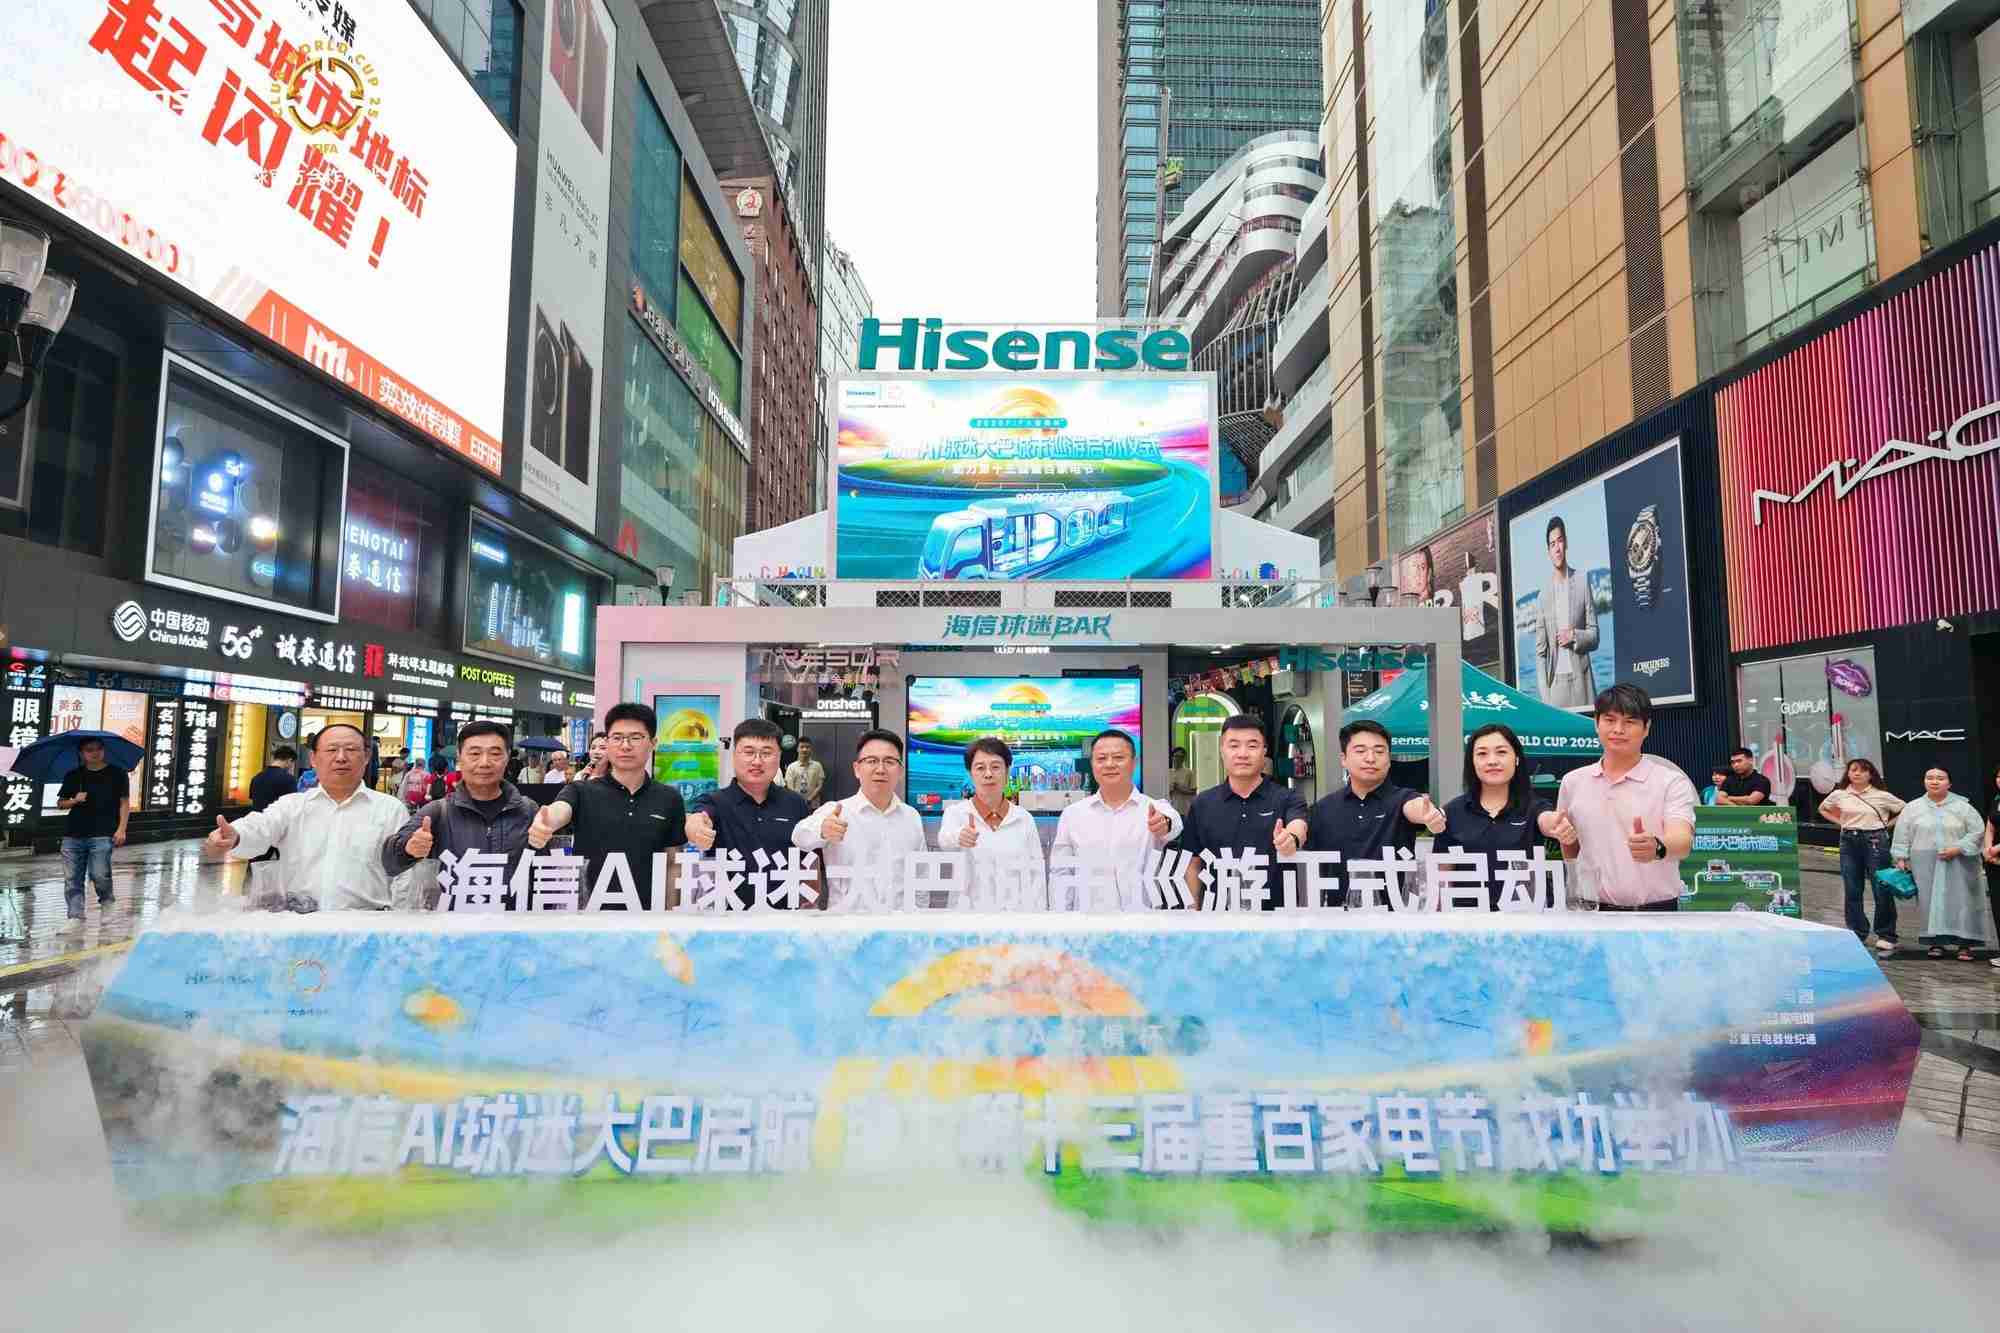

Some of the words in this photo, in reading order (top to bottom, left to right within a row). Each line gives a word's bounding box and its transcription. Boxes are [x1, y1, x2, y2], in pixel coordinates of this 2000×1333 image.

[859, 317, 1191, 371] Hisense
[347, 524, 405, 561] ENGTAI
[150, 607, 210, 636] 中国移动
[942, 613, 1112, 641] 海信球迷BAR
[149, 629, 178, 647] China
[178, 634, 209, 650] Mobile
[275, 633, 356, 674] 诚泰通信
[461, 666, 481, 681] POST
[3, 697, 41, 811] 眼镜发
[1390, 736, 1431, 745] sense
[1543, 736, 1567, 747] CUP
[1570, 738, 1600, 749] 2025
